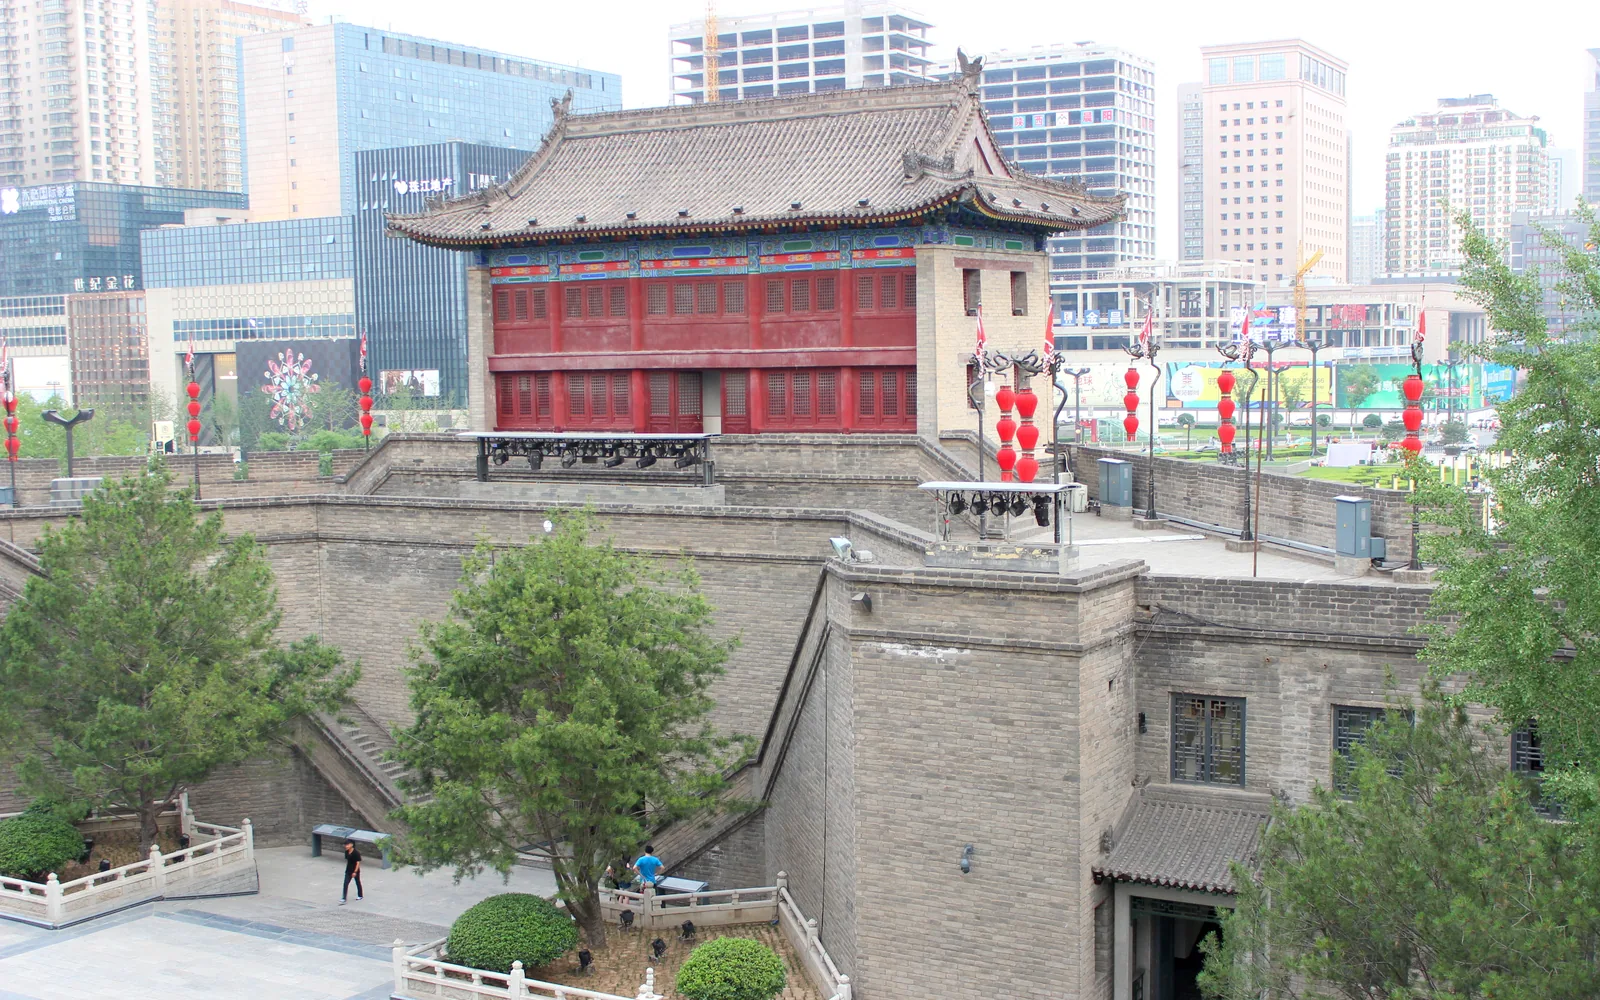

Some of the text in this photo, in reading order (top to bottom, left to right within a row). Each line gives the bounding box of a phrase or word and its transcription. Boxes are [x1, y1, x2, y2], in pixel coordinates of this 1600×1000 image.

[408, 177, 453, 193] 珠江地产
[74, 274, 135, 292] 世纪金花
